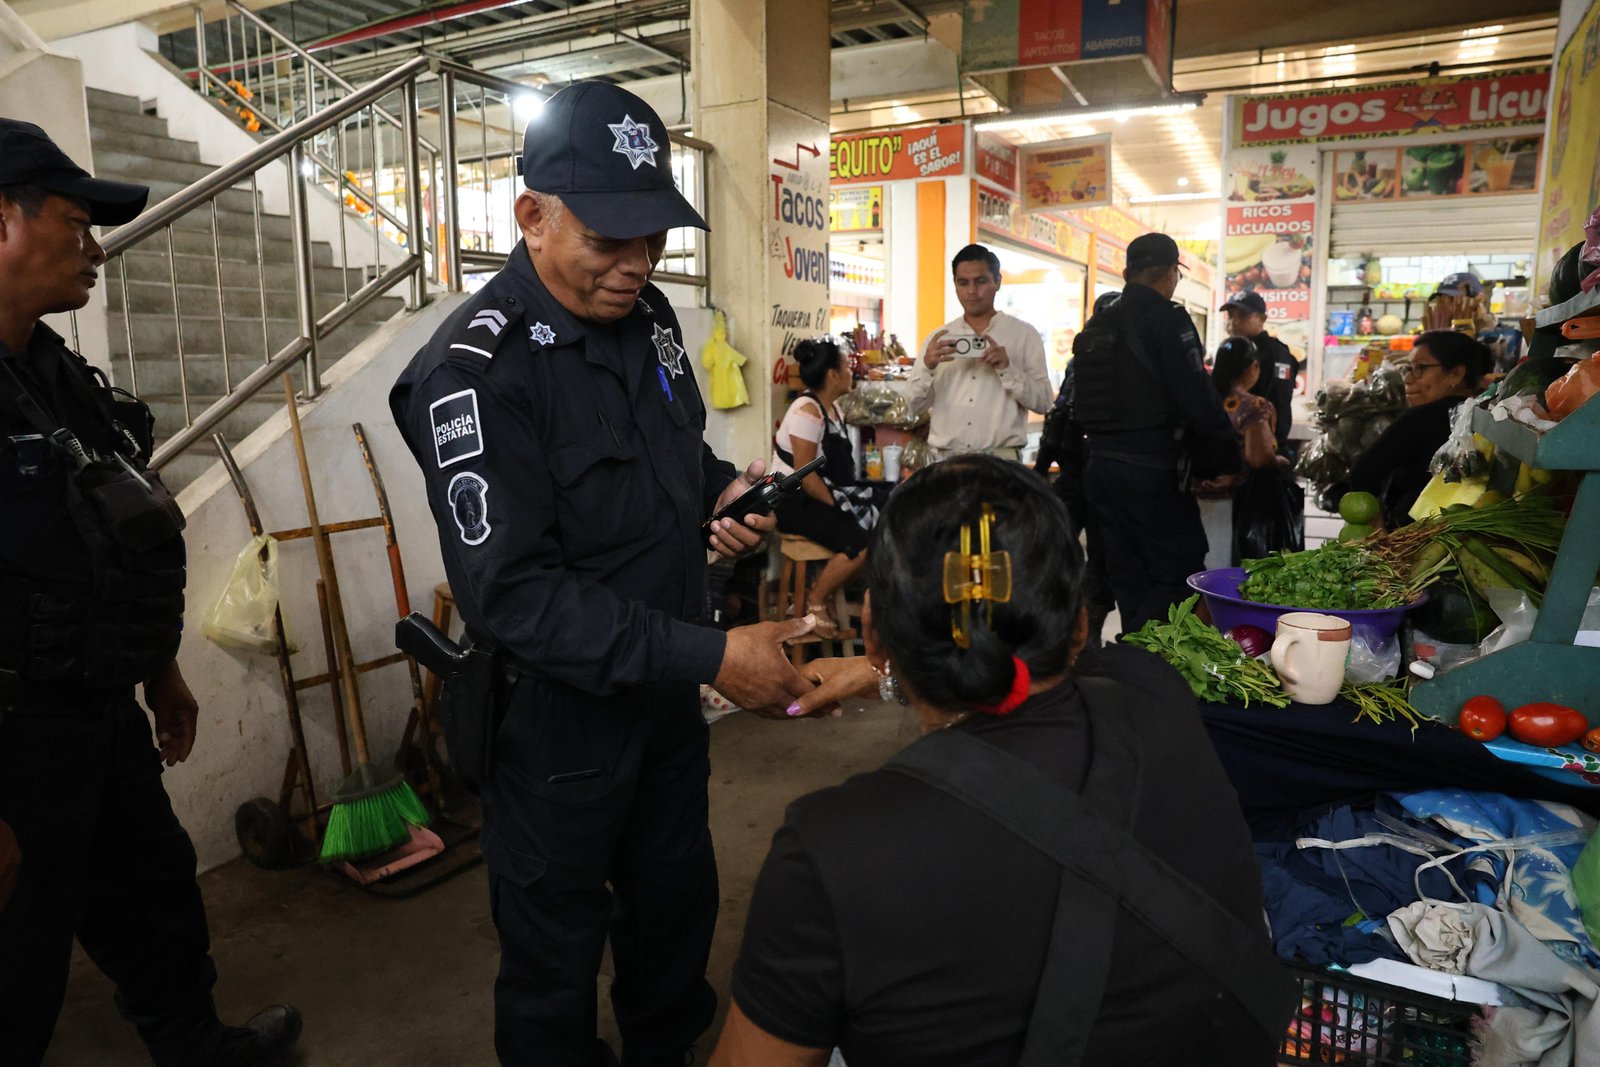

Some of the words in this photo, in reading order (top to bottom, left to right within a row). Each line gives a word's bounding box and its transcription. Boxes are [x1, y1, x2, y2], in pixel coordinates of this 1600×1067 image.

[1034, 28, 1065, 42] TACOS
[1084, 36, 1142, 51] ABARROTES
[1245, 98, 1387, 136] Jugos
[907, 130, 938, 156] ¡AQUÍ
[1316, 135, 1336, 143] DE
[1339, 130, 1399, 141] FRUTAS
[913, 152, 927, 166] ES
[930, 146, 942, 159] EL
[920, 151, 960, 177] SABOR!
[771, 174, 824, 231] Tacos
[978, 190, 1011, 233] TACOS
[1242, 206, 1293, 218] RICOS
[1228, 220, 1312, 235] LICUADOS
[771, 304, 811, 330] TAQUERIA
[436, 413, 474, 436] POLICÍA
[437, 424, 475, 446] ESTATAL
